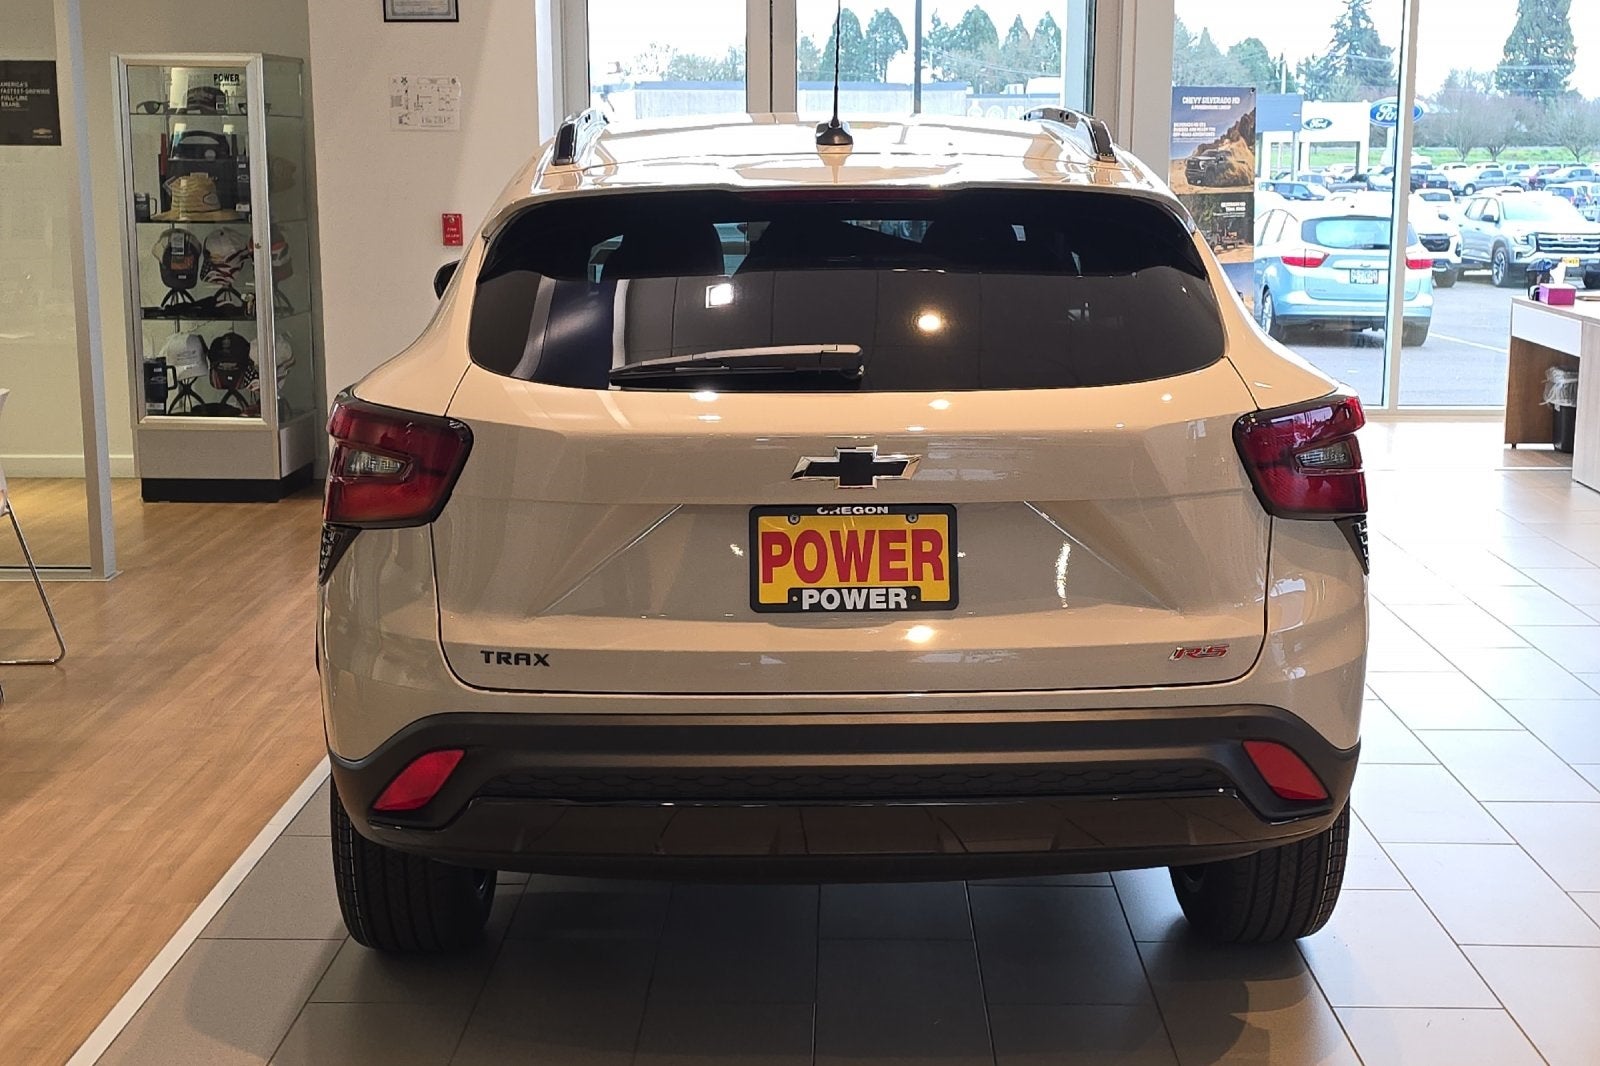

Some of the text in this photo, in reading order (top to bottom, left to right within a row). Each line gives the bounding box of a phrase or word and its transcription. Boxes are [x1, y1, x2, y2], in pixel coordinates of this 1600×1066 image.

[213, 73, 240, 82] POWER
[761, 529, 944, 584] POWER
[802, 588, 908, 610] POWER
[480, 650, 550, 667] TRAX
[1169, 644, 1230, 661] RS
